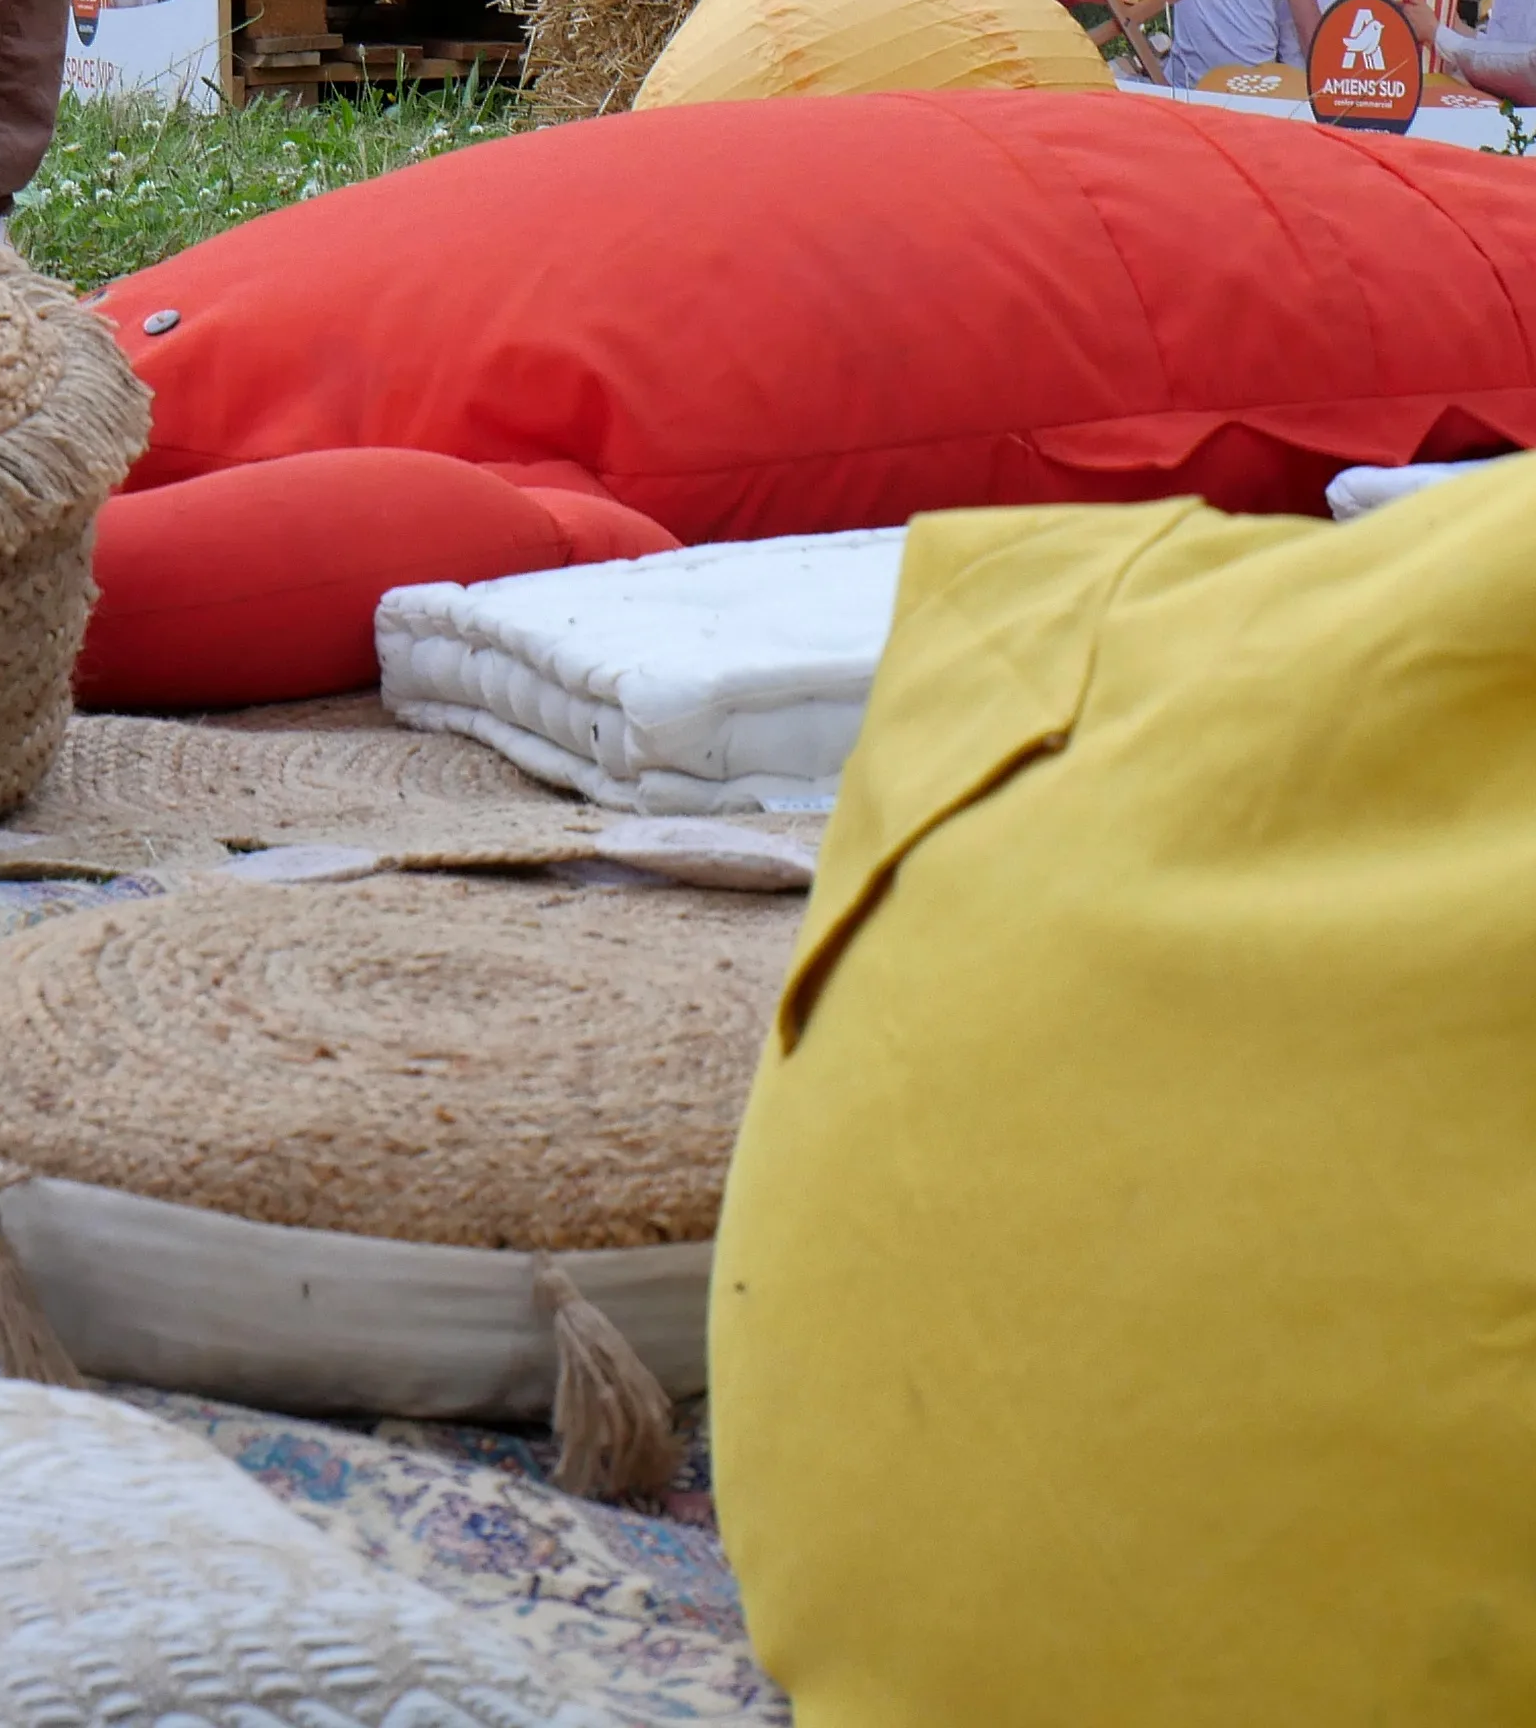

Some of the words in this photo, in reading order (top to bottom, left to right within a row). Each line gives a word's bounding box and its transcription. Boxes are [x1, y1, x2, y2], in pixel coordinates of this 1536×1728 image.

[63, 56, 95, 88] SPACE
[1323, 78, 1376, 96] AMIENS
[1379, 80, 1406, 98] SUD
